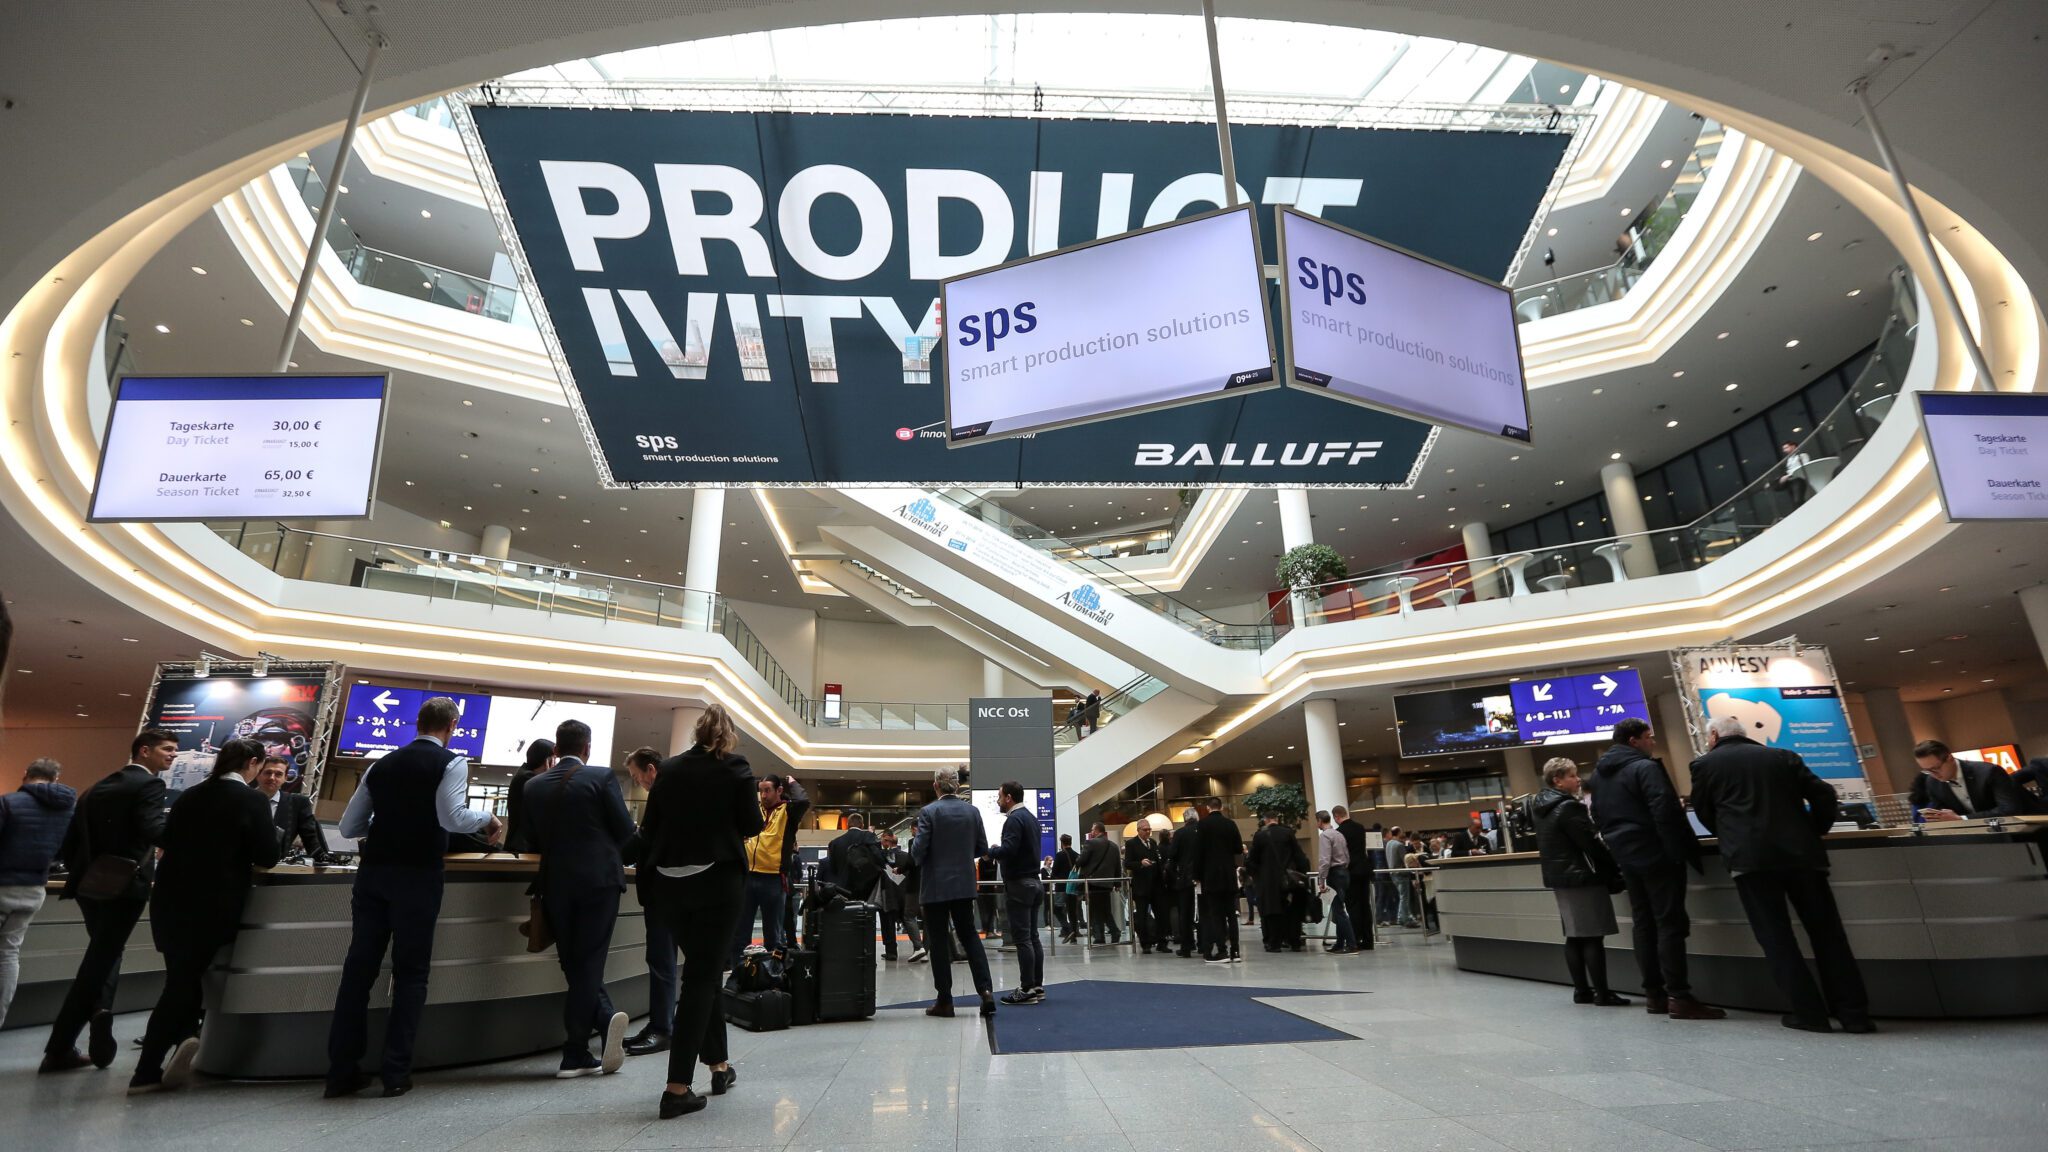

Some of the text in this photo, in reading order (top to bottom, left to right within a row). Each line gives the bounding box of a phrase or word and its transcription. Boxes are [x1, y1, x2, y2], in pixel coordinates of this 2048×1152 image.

[1298, 256, 1367, 306] sps
[959, 301, 1038, 352] sps
[581, 287, 942, 384] IVITY
[960, 306, 1250, 382] smart production solutions
[1301, 310, 1515, 386] smart production solutions
[170, 421, 235, 433] Tageskarte
[272, 420, 322, 432] 30,00 €
[166, 435, 229, 447] Day Ticket
[635, 434, 679, 452] sps
[1974, 434, 2027, 444] Tageskarte
[642, 454, 779, 463] smart production solutions
[1134, 441, 1384, 466] BALLUFF
[159, 472, 227, 482] Dauerkarte
[264, 470, 314, 481] 65,00 €
[1988, 479, 2041, 488] Dauerkarte
[156, 487, 240, 497] Season Ticket
[282, 490, 304, 498] 32,50
[978, 707, 1030, 718] NCC Ost
[372, 728, 387, 738] 4A
